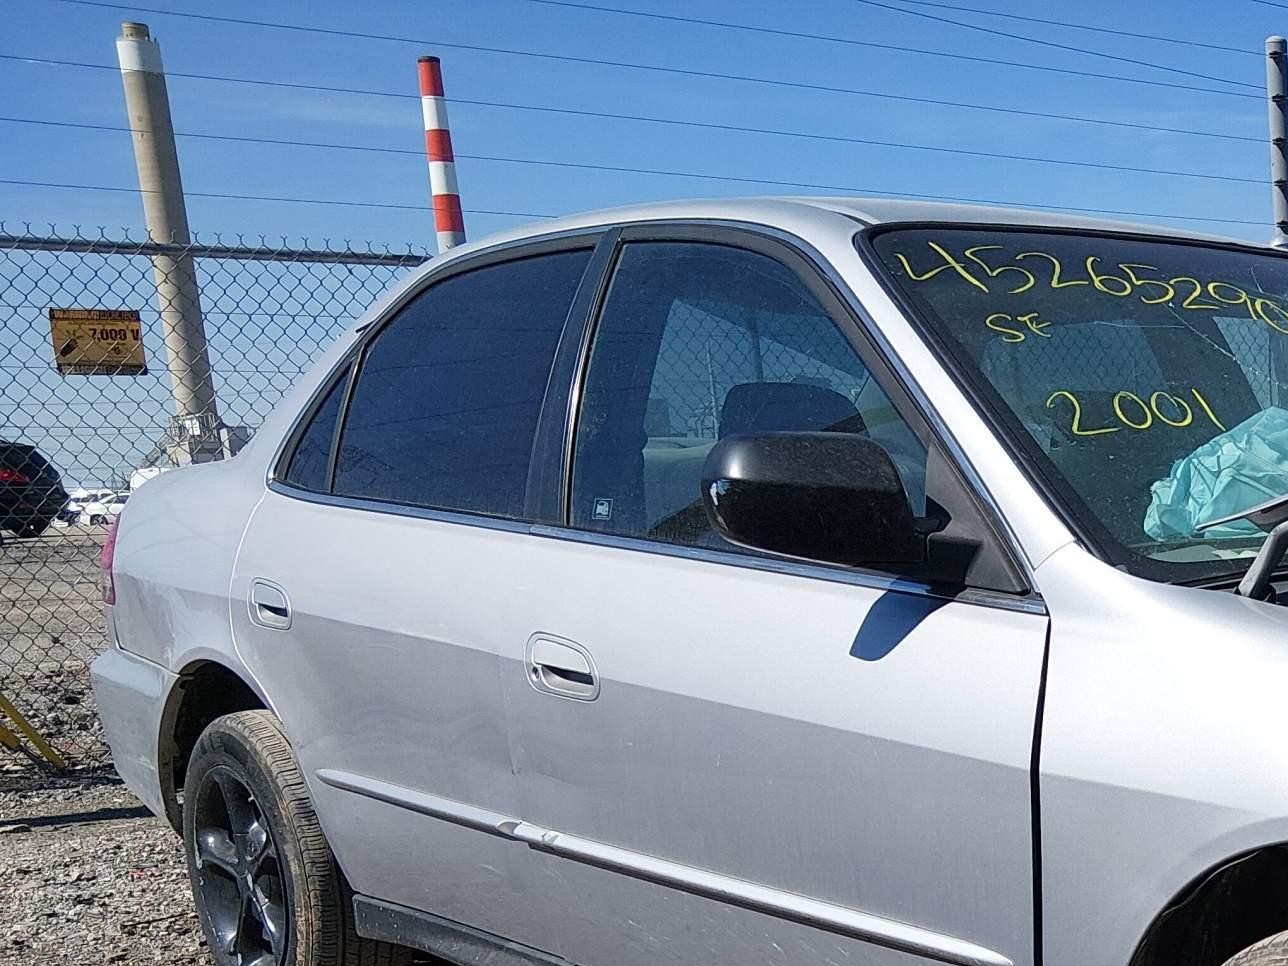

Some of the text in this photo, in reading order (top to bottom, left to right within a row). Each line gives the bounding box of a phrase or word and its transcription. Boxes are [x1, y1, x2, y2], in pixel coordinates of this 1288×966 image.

[88, 327, 140, 343] 7,000 V
[1046, 387, 1228, 436] 2001
